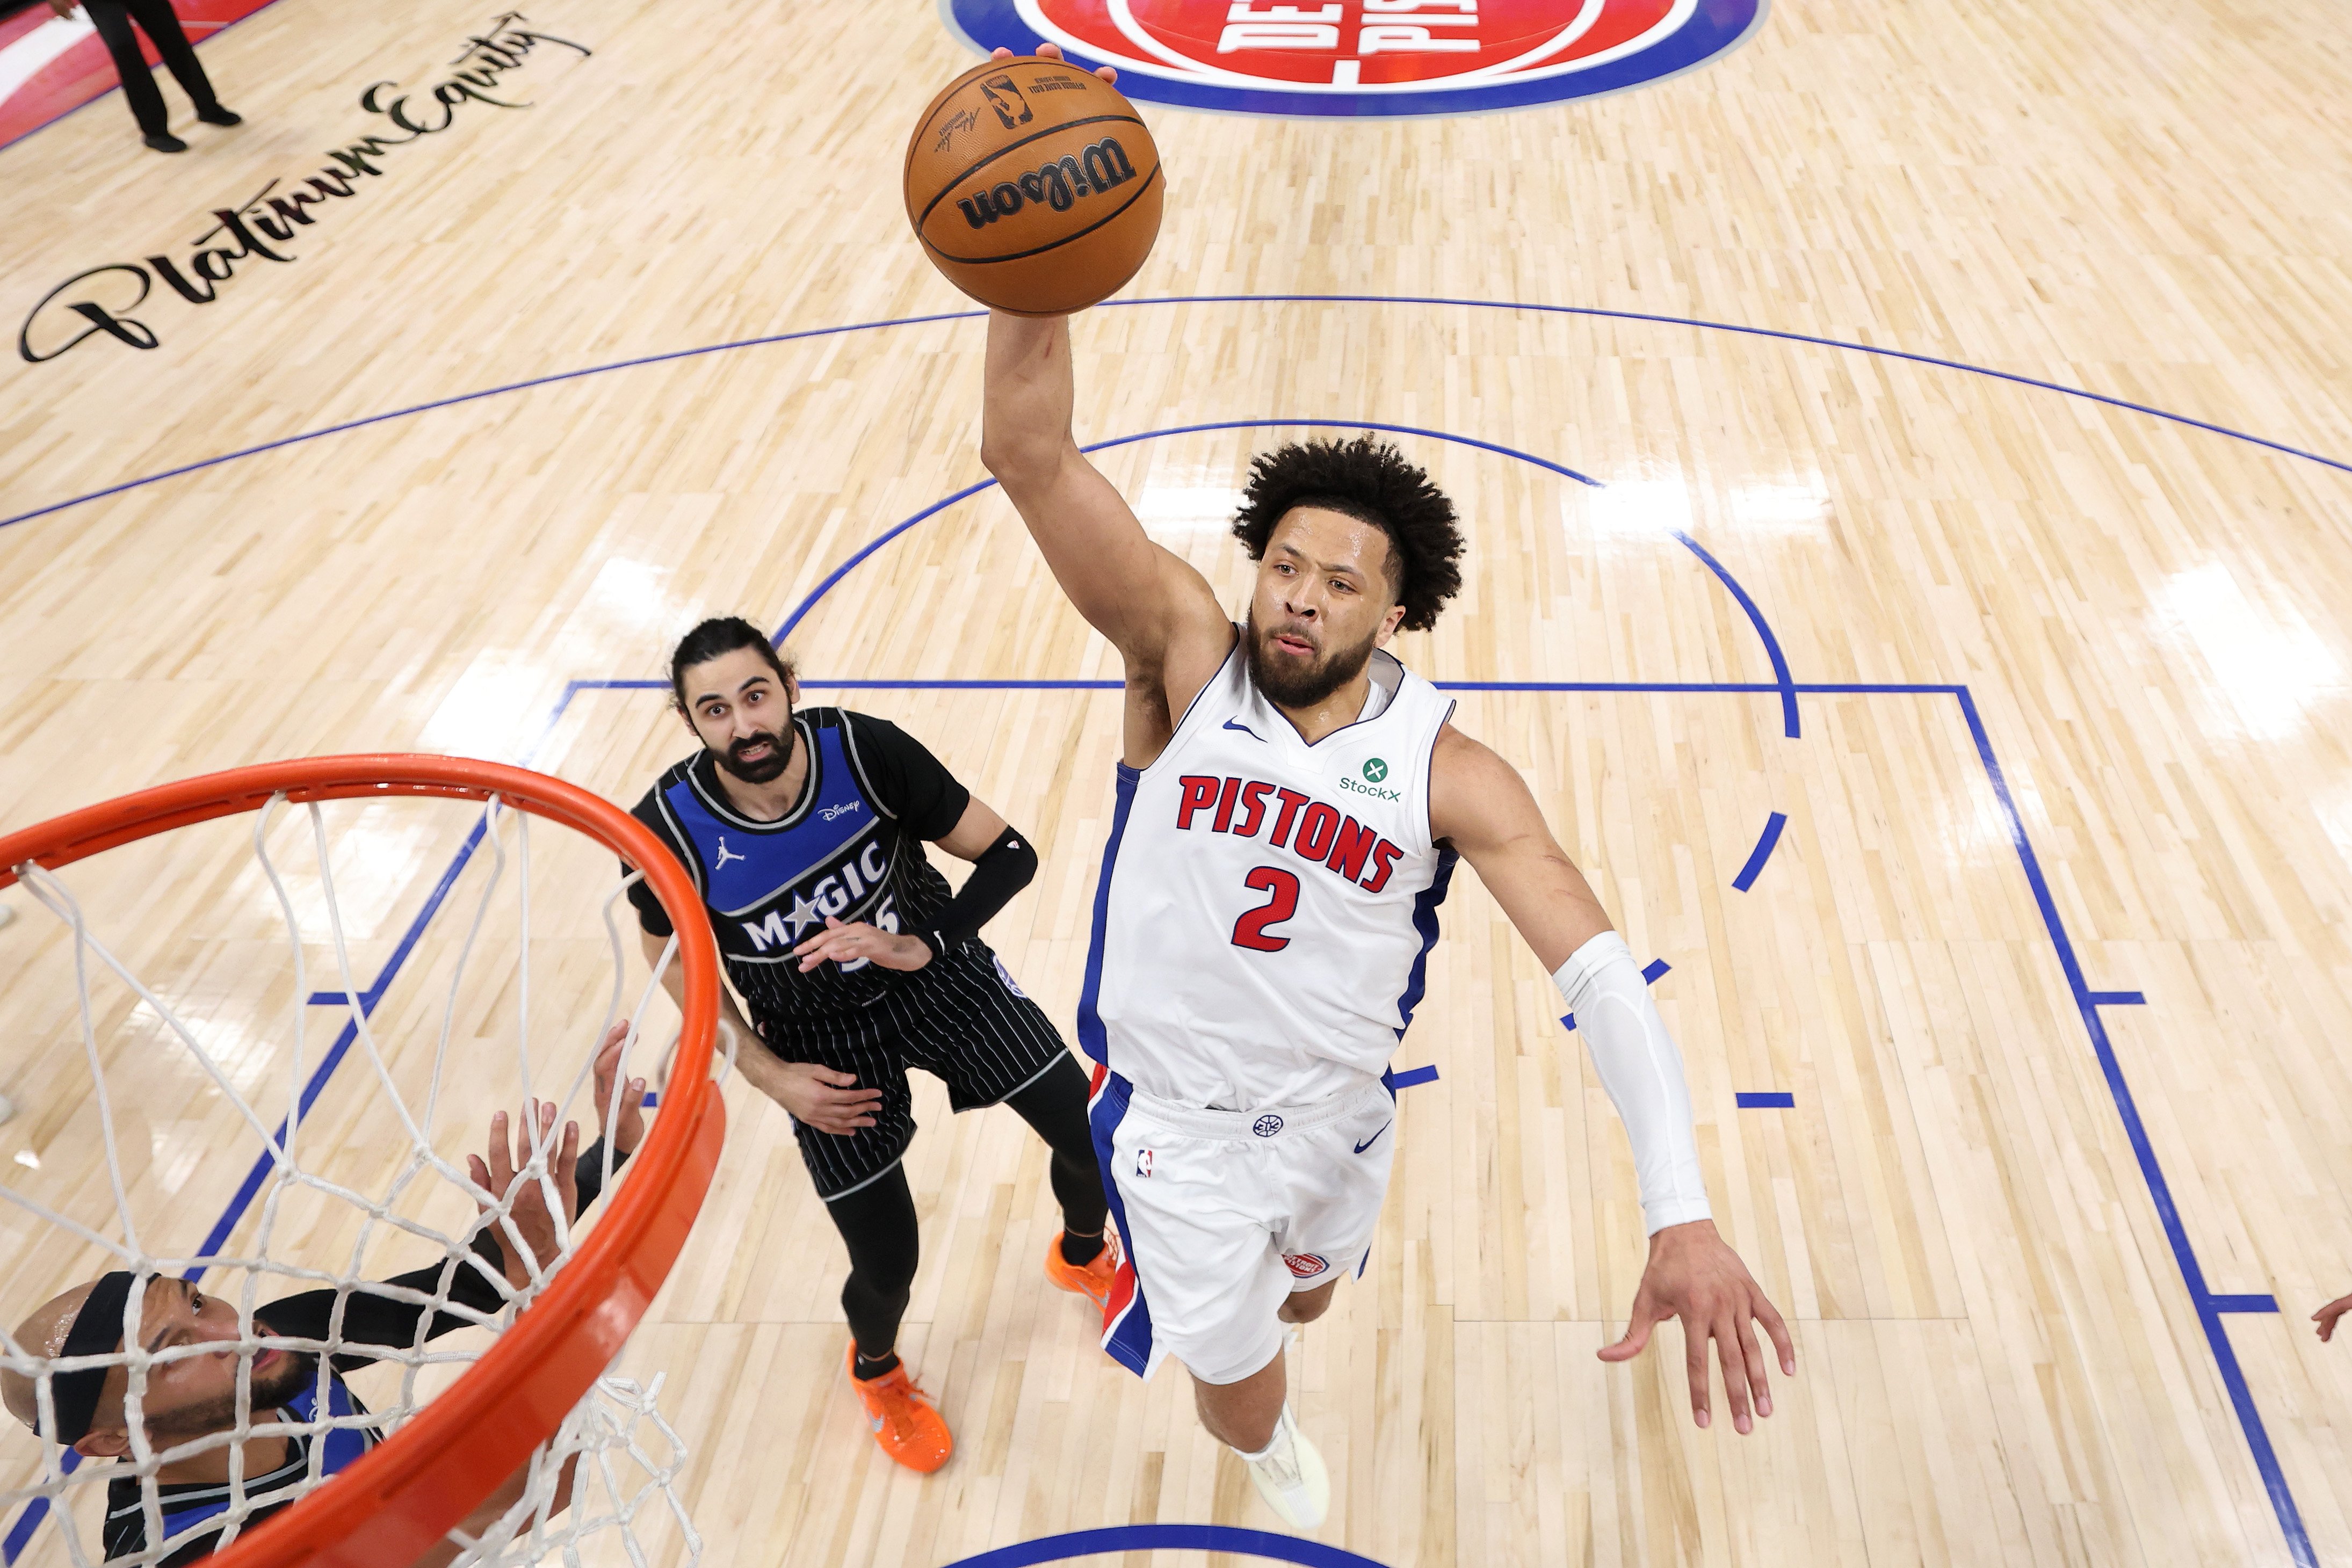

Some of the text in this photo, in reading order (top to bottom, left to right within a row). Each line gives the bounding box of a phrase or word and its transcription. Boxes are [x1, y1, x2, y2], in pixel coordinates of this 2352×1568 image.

[1215, 0, 1343, 54] DE
[19, 11, 592, 363] Platinum Equity
[957, 136, 1137, 229] Wilson
[1176, 775, 1405, 894] PISTONS
[1340, 777, 1401, 803] StockX
[1231, 866, 1300, 952] 2
